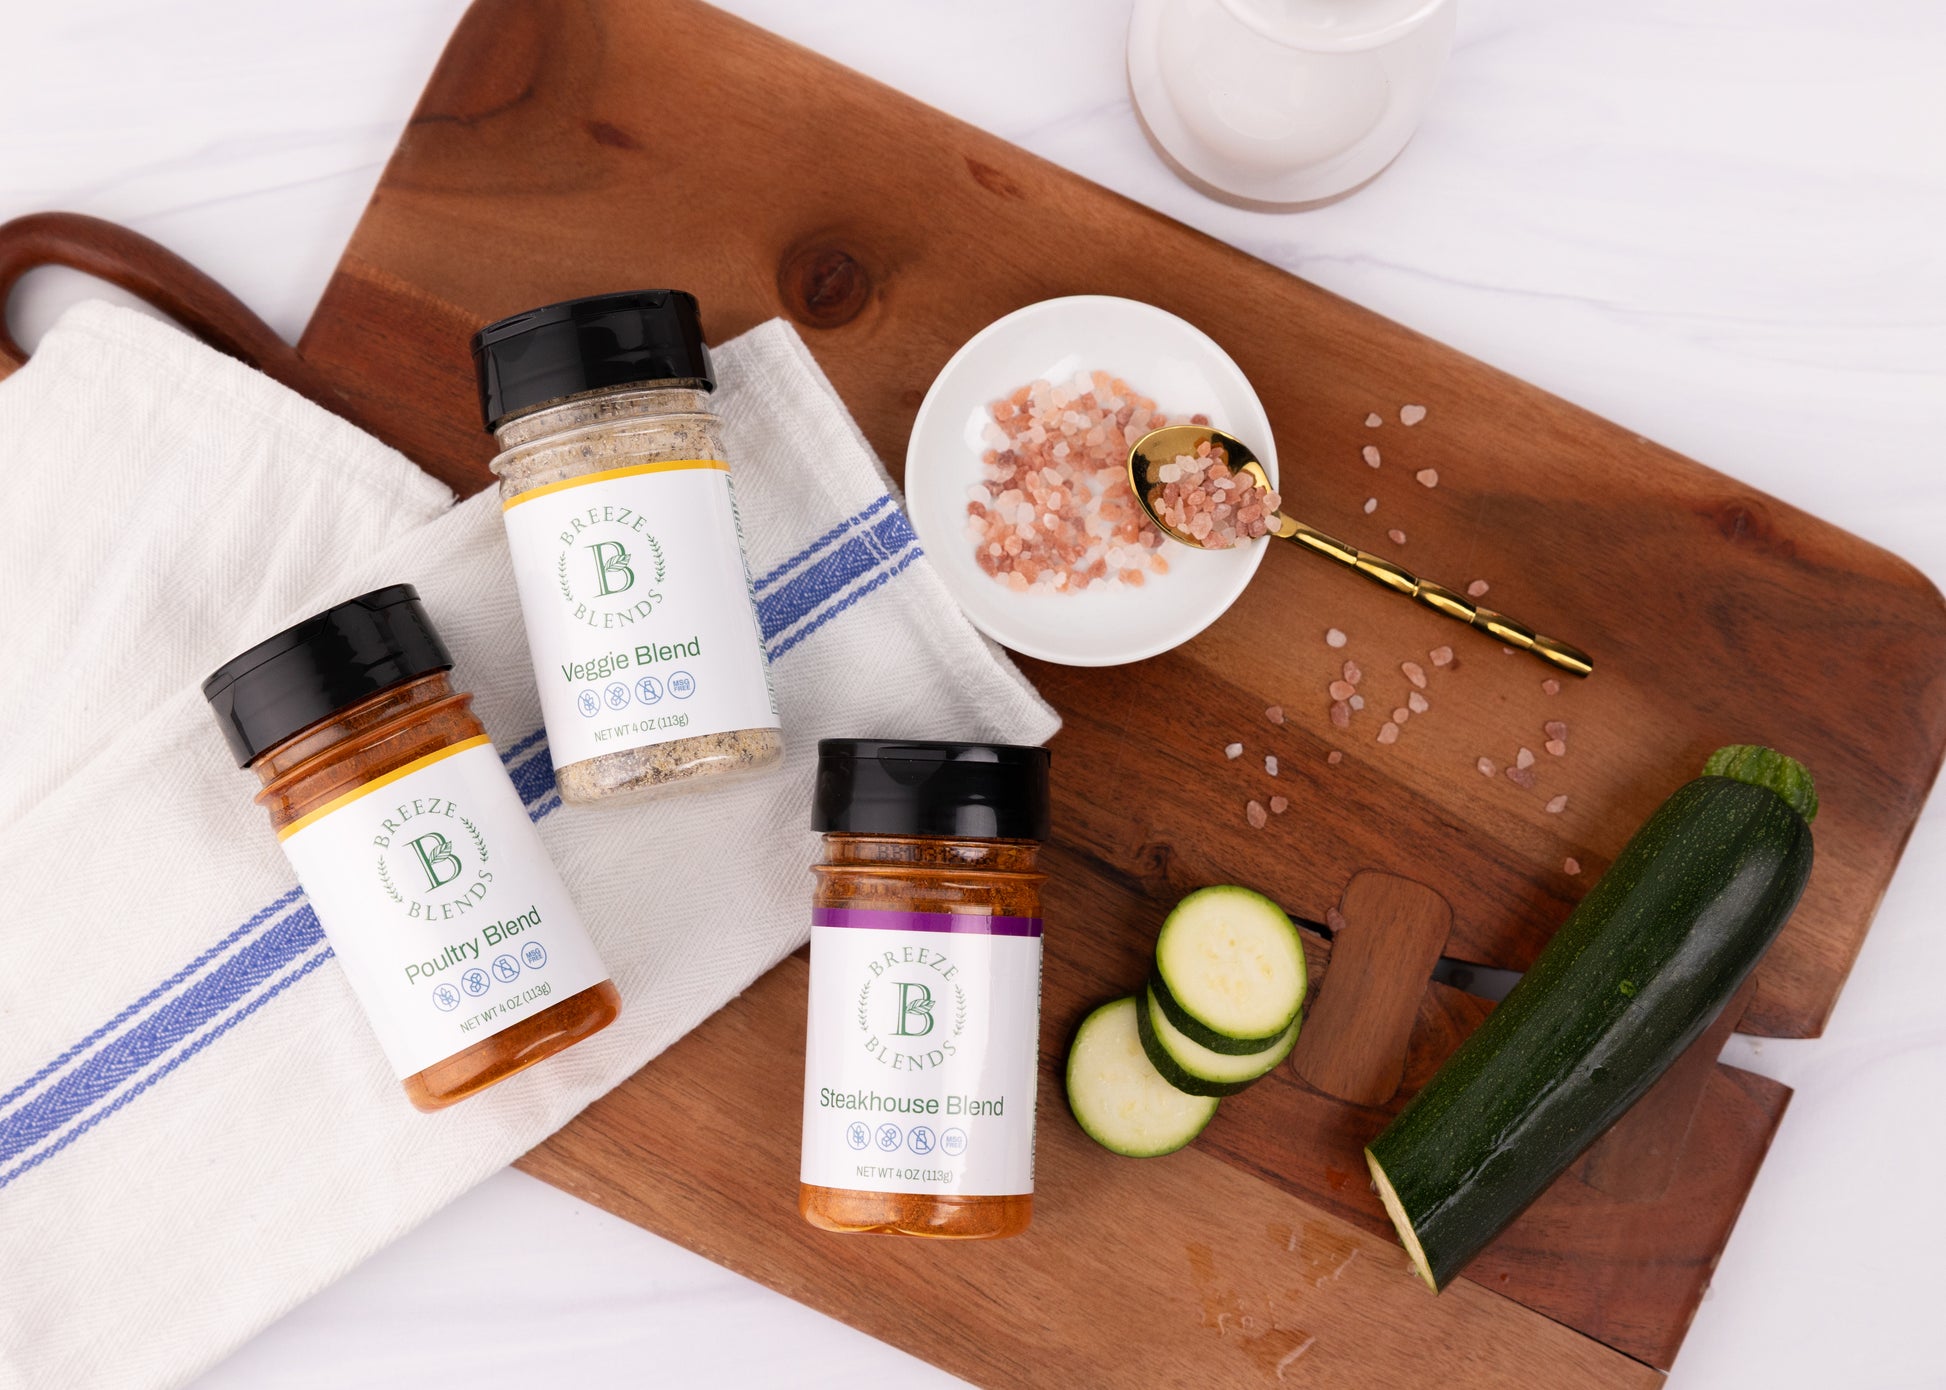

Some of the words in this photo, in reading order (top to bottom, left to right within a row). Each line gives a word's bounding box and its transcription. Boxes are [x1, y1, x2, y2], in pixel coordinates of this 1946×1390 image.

[560, 506, 647, 546] BREEZE
[584, 541, 635, 598] B
[573, 589, 663, 628] BLENDS
[561, 651, 630, 682] Veggie
[635, 636, 701, 666] Blend
[672, 678, 690, 688] MSG
[674, 684, 691, 692] FREE
[594, 730, 613, 742] NET
[614, 724, 630, 737] WT
[632, 722, 639, 732] 4
[640, 719, 656, 732] OZ
[657, 712, 689, 730] (113g)
[373, 798, 457, 850] BREEZE
[401, 832, 462, 893] B
[408, 869, 493, 921] BLENDS
[404, 938, 480, 985] Poultry
[482, 905, 542, 946] Blend
[525, 947, 541, 959] MSG
[528, 954, 543, 964] FREE
[868, 946, 959, 982] BREEZE
[460, 1016, 481, 1034] NET
[480, 1006, 499, 1022] WT
[499, 1003, 506, 1014] 4
[506, 995, 523, 1011] OZ
[522, 981, 552, 1004] (113g)
[888, 982, 936, 1037] B
[864, 1035, 957, 1072] BLENDS
[820, 1087, 939, 1115] Steakhouse
[946, 1095, 1004, 1116] Blend
[946, 1135, 962, 1143] MSG
[856, 1166, 877, 1178] NET
[878, 1167, 895, 1179] WT
[896, 1168, 902, 1179] 4
[904, 1168, 919, 1180] OZ
[922, 1169, 953, 1183] (113g)
